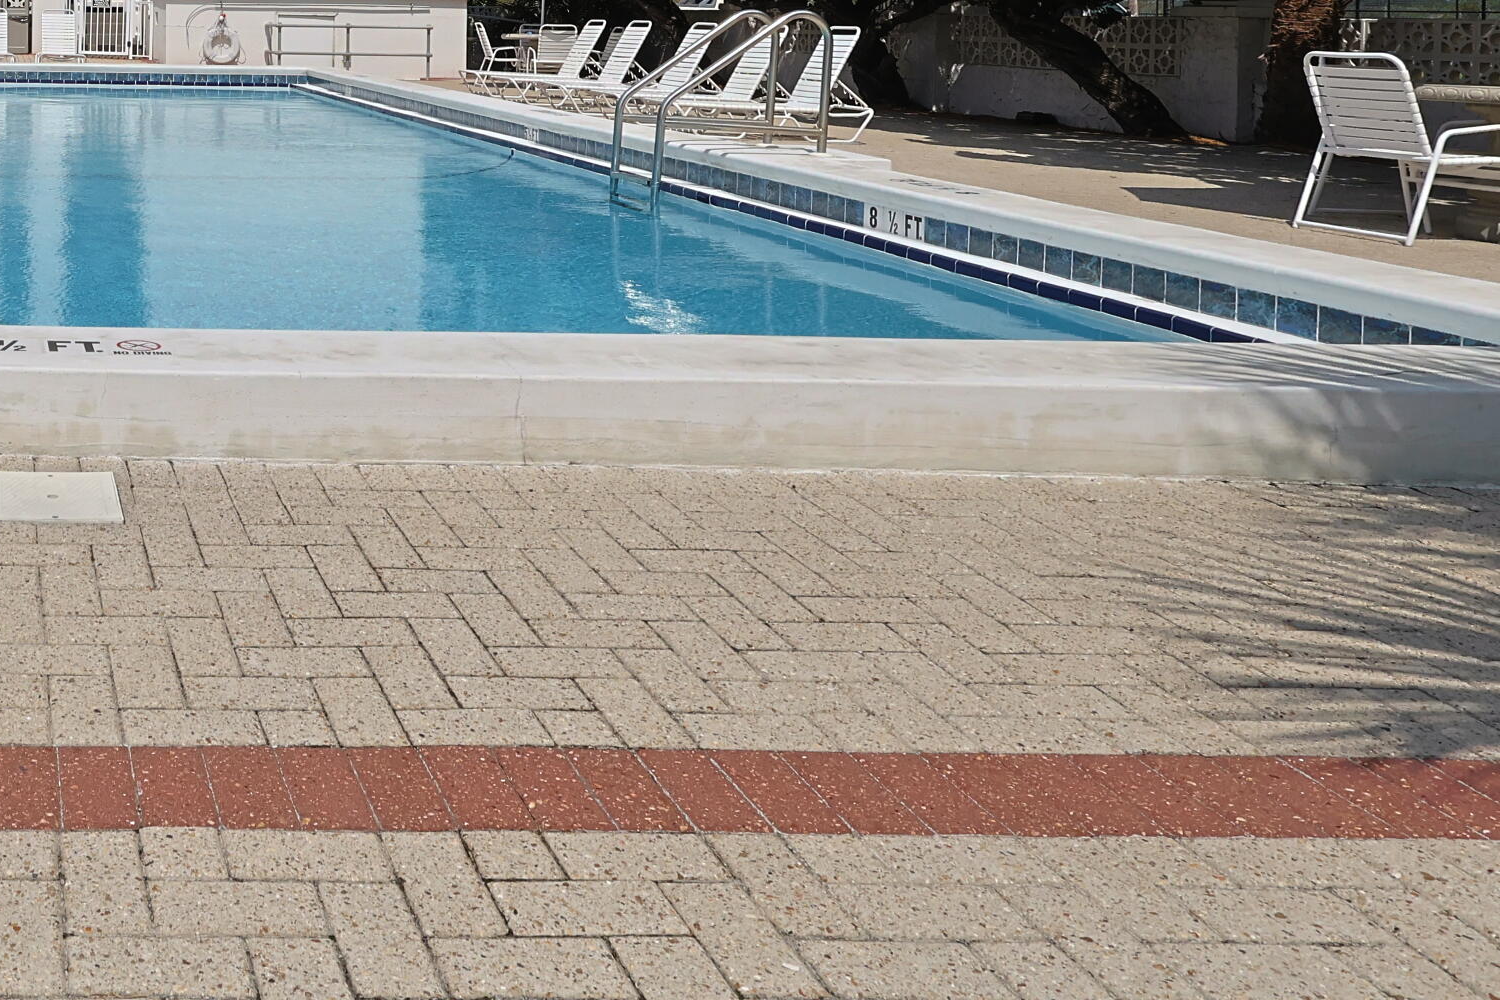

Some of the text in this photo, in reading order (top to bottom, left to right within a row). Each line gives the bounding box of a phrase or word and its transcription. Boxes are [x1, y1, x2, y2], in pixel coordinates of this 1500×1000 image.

[869, 206, 878, 228] 8
[905, 214, 923, 240] FT.
[47, 340, 103, 353] FT.
